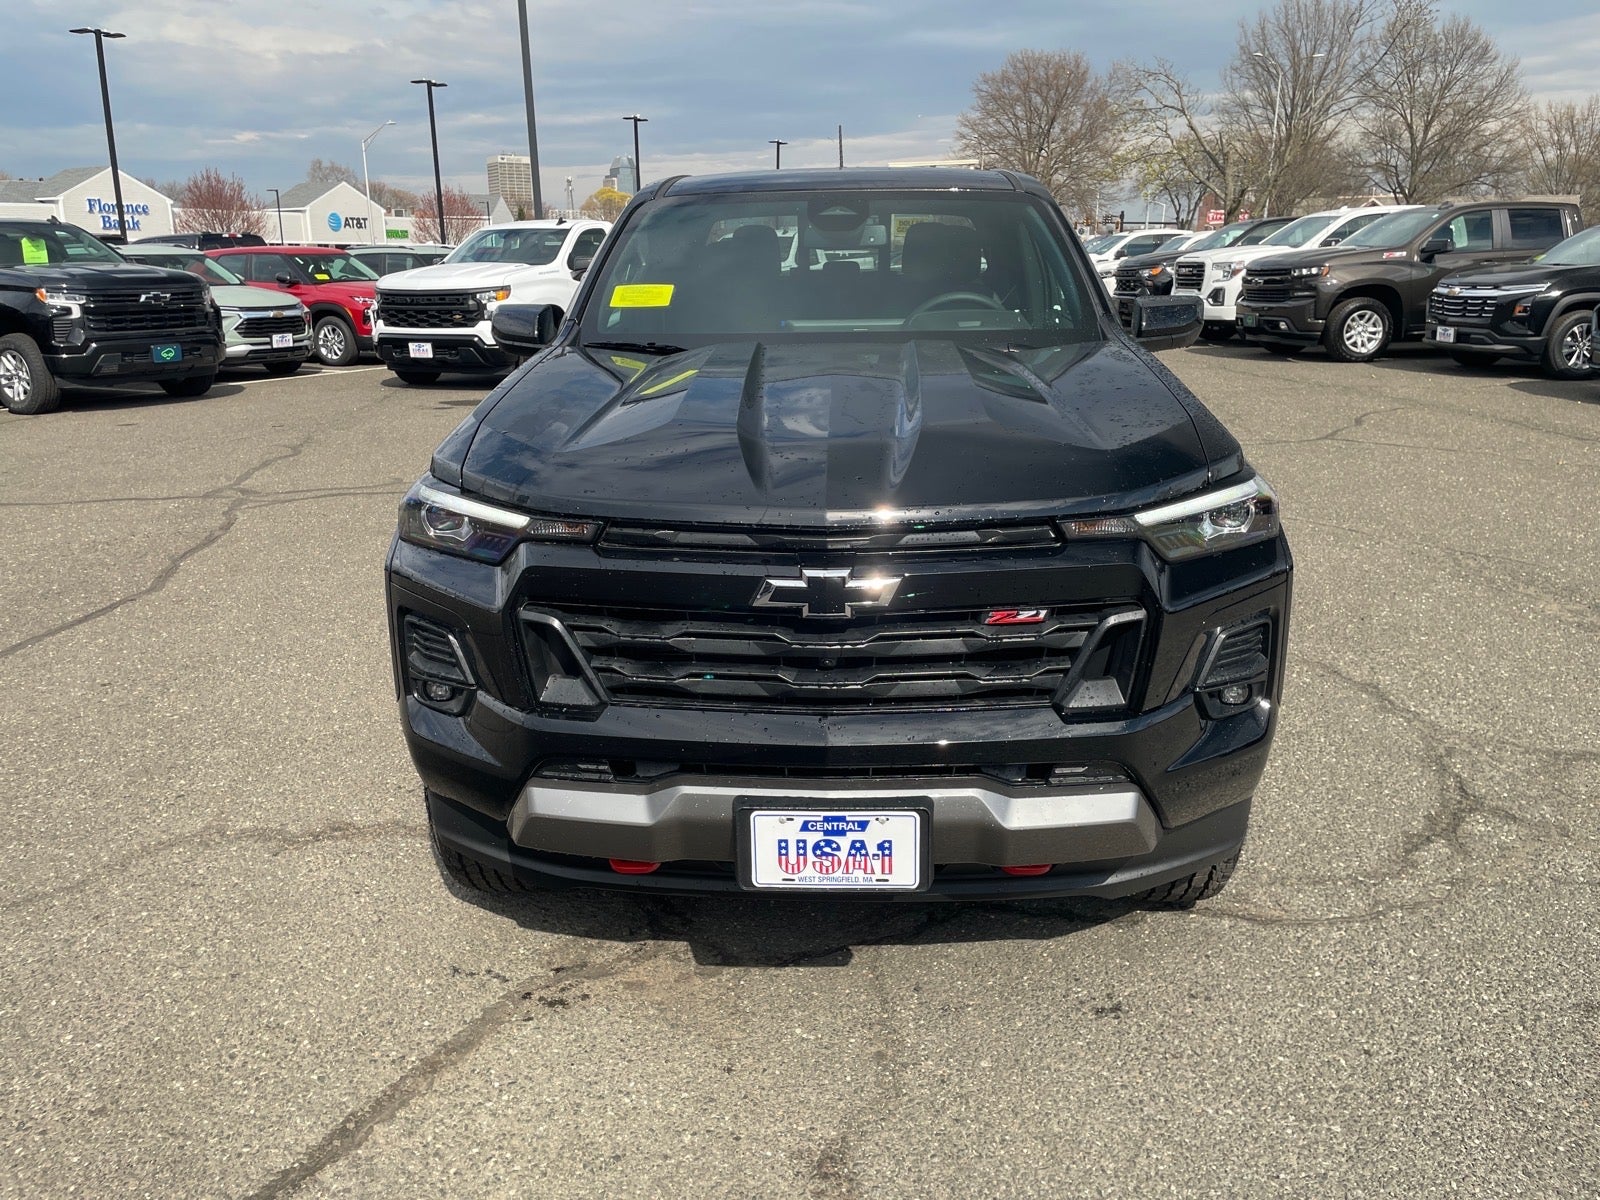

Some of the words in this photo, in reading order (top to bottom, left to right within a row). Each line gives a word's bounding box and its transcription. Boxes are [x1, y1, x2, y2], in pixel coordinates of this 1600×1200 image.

[87, 198, 149, 215] Flornce
[343, 217, 368, 229] AT&T
[807, 821, 862, 831] CENTRAL
[797, 875, 815, 884] WEST
[862, 875, 873, 884] MA
